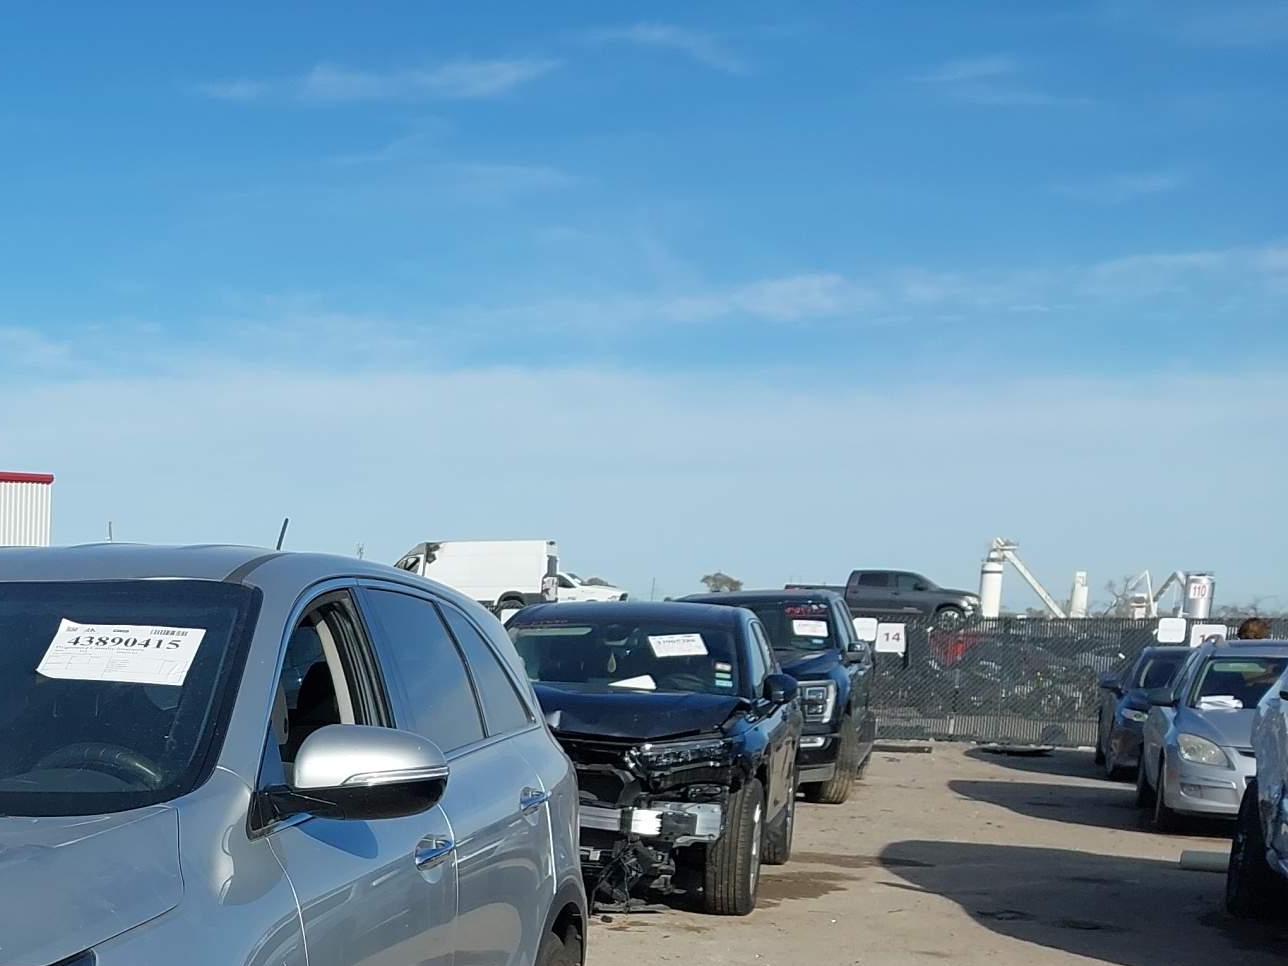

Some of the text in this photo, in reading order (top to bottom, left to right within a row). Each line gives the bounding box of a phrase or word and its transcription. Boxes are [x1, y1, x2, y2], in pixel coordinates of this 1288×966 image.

[1192, 585, 1207, 597] 110
[67, 635, 182, 651] 43890415
[883, 632, 901, 642] 14
